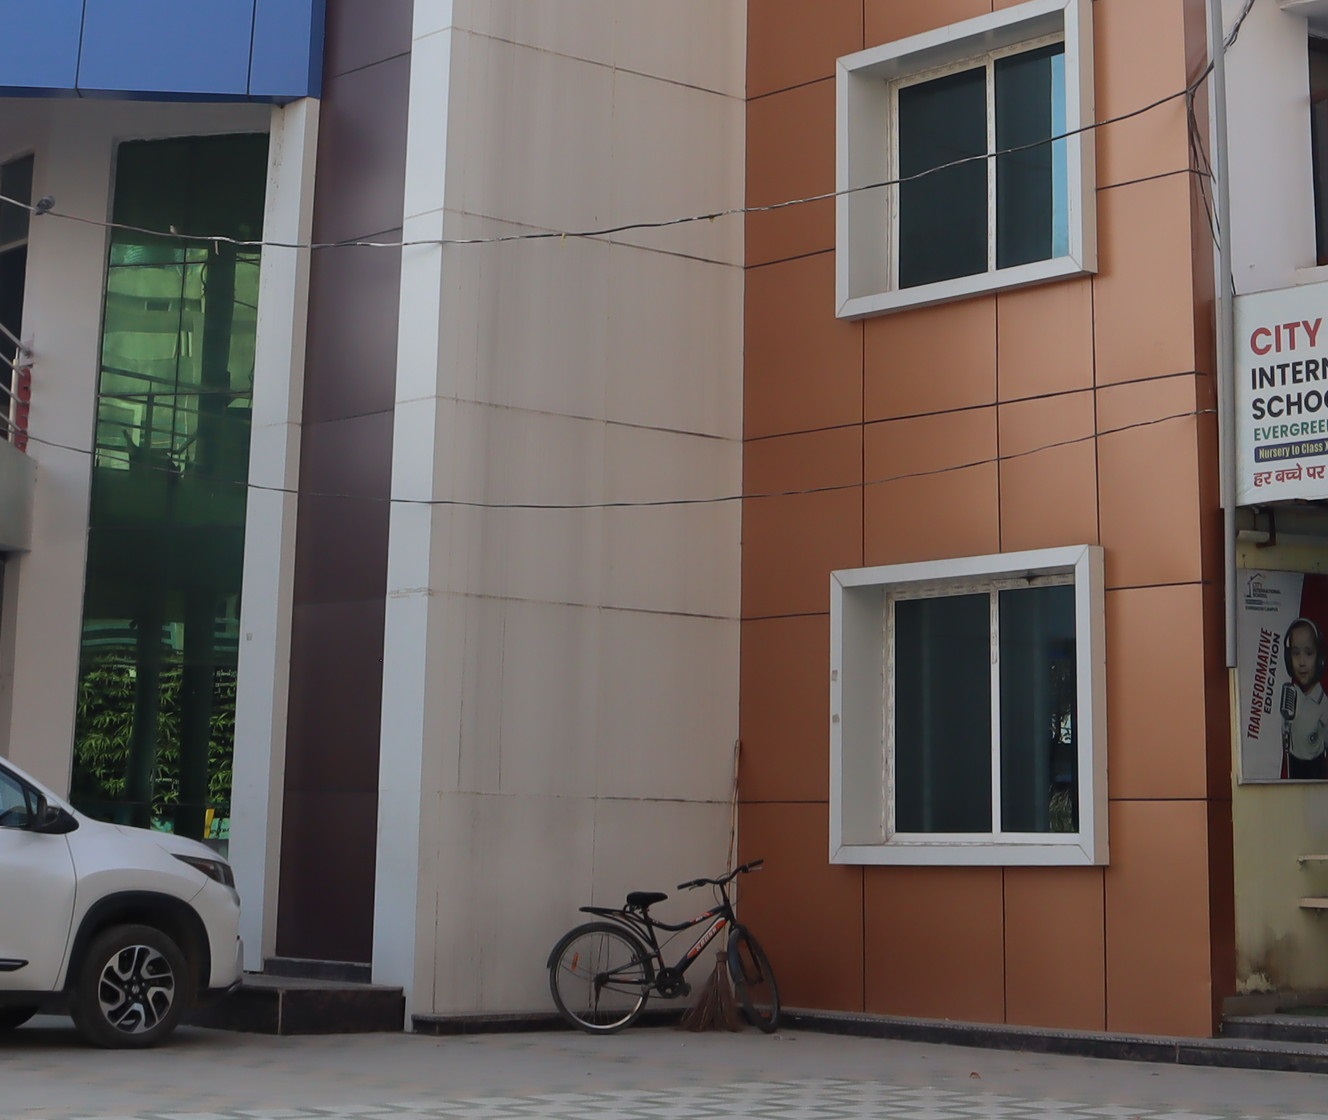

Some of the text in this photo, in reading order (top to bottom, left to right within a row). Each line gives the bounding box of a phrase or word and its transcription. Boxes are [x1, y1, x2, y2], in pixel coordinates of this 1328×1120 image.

[1250, 317, 1323, 356] CITY
[1258, 446, 1290, 460] Nursery
[1291, 444, 1300, 454] to
[1301, 441, 1323, 454] Class
[1253, 471, 1273, 487] हर
[1275, 463, 1303, 483] बच्चे
[1306, 464, 1326, 480] पर
[1247, 627, 1272, 740] TRANSFORMATIVE
[1264, 632, 1281, 715] EDUCATION
